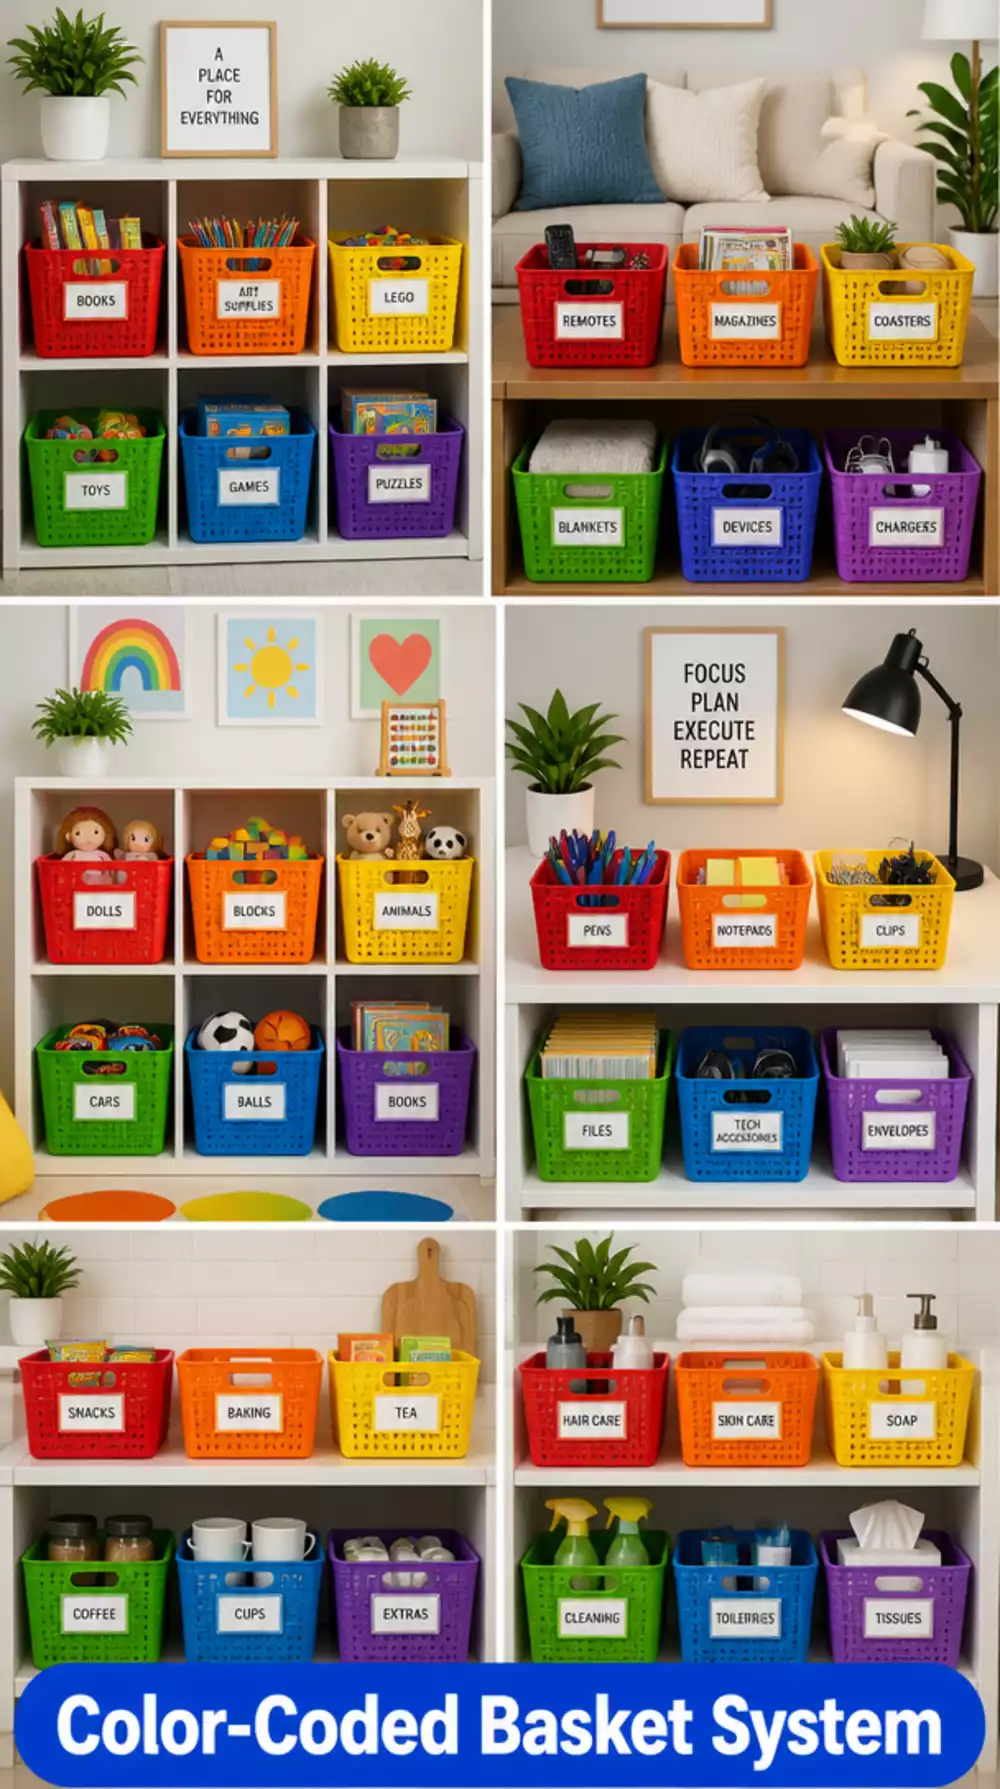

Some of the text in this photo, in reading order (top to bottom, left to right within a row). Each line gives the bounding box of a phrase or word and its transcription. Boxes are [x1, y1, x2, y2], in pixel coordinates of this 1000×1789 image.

[214, 47, 224, 62] A
[198, 67, 241, 83] PLACE
[206, 88, 233, 105] FOR
[180, 110, 259, 126] EVERYTHING
[76, 294, 116, 307] BOOKS
[384, 291, 415, 304] LEGO
[224, 300, 274, 312] SUPPLIES
[562, 315, 617, 328] REMOTES
[714, 315, 777, 328] MAGAZINES
[874, 315, 932, 328] COASTERS
[229, 480, 270, 493] GAMES
[375, 477, 423, 490] PUZZLES
[81, 484, 111, 497] TOYS
[558, 520, 618, 534] BLANKETS
[722, 520, 773, 534] DEVICES
[684, 662, 746, 684] FOCUS
[691, 691, 739, 713] PLAN
[673, 719, 756, 741] EXECUTE
[680, 748, 749, 769] REPEAT
[86, 905, 123, 917] DOLLS
[233, 905, 276, 917] BLOCKS
[381, 905, 432, 917] ANIMALS
[583, 924, 613, 937] PENS
[717, 924, 773, 937] NOTEPADS
[875, 924, 906, 937] CLIPS
[89, 1095, 121, 1108] CARS
[237, 1095, 273, 1109] BALLS
[388, 1095, 427, 1108] BOOKS
[581, 1124, 613, 1137] FILES
[734, 1118, 761, 1131] TECH
[867, 1124, 929, 1137] ENVELOPES
[67, 1406, 116, 1420] SNACKS
[227, 1406, 271, 1420] BAKING
[395, 1406, 418, 1419] TEA
[563, 1414, 621, 1427] HAIR CARE
[717, 1414, 775, 1427] SKIN CARE
[886, 1414, 919, 1427] SOAP
[72, 1607, 116, 1621] COFFEE
[234, 1607, 266, 1621] CUPS
[382, 1607, 429, 1621] EXTRAS
[564, 1611, 621, 1624] CLEANING
[875, 1612, 923, 1625] TISSUES
